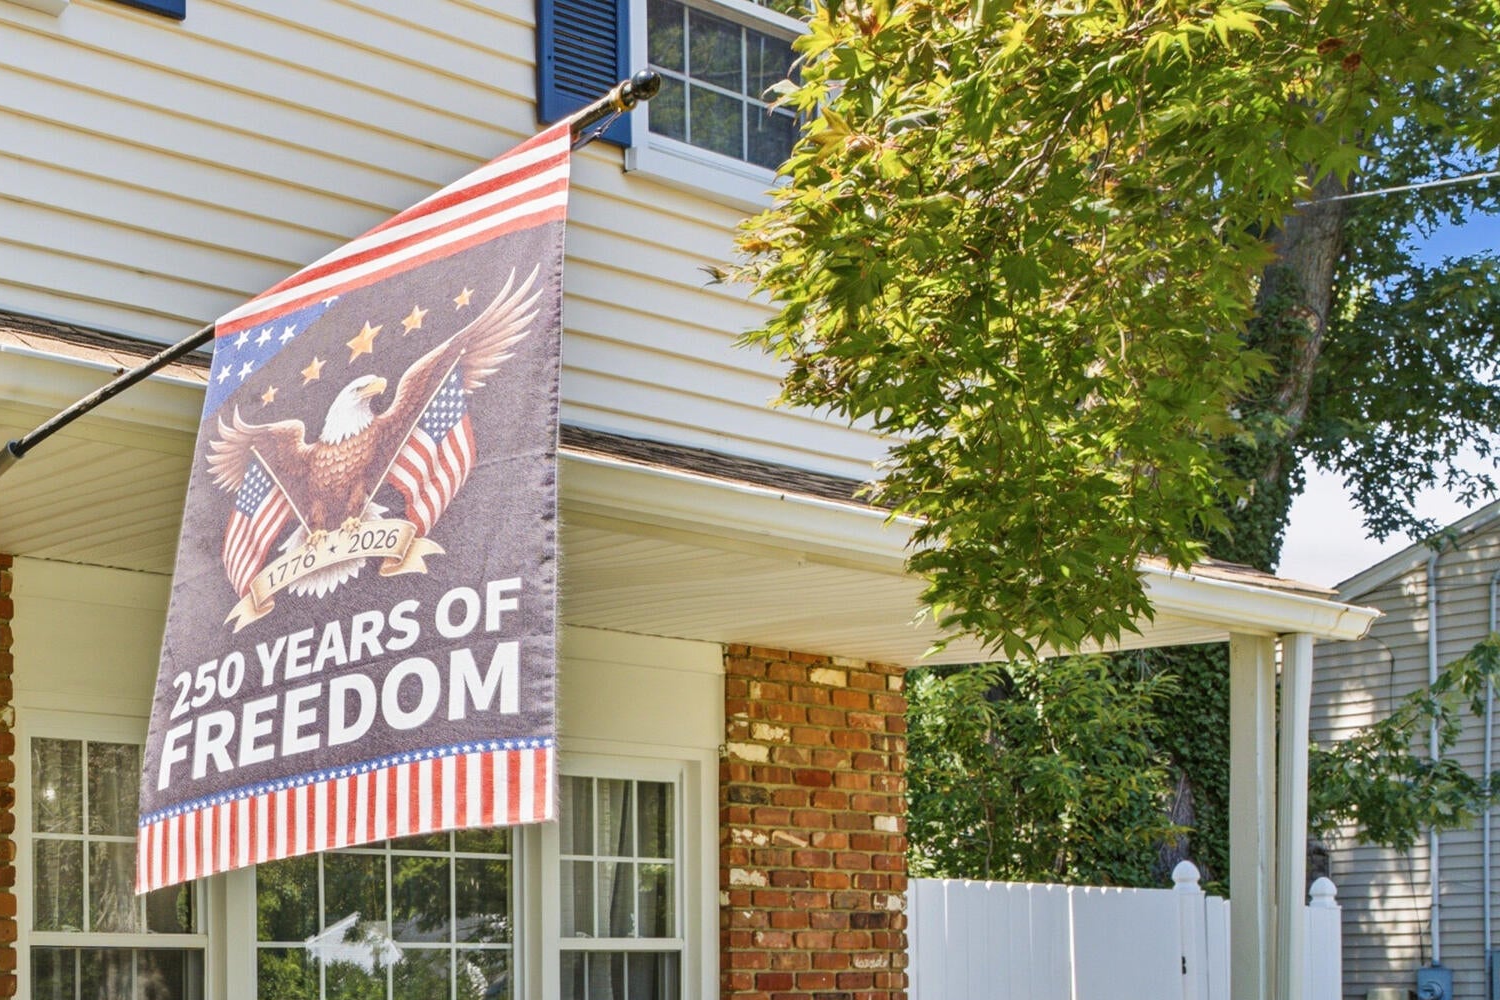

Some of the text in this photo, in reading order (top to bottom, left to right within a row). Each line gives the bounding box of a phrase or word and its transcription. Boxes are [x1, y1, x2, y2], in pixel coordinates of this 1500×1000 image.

[267, 528, 399, 588] 1776 2026
[157, 641, 519, 791] FREEDOM
[170, 577, 522, 720] 250 YEARS OF
